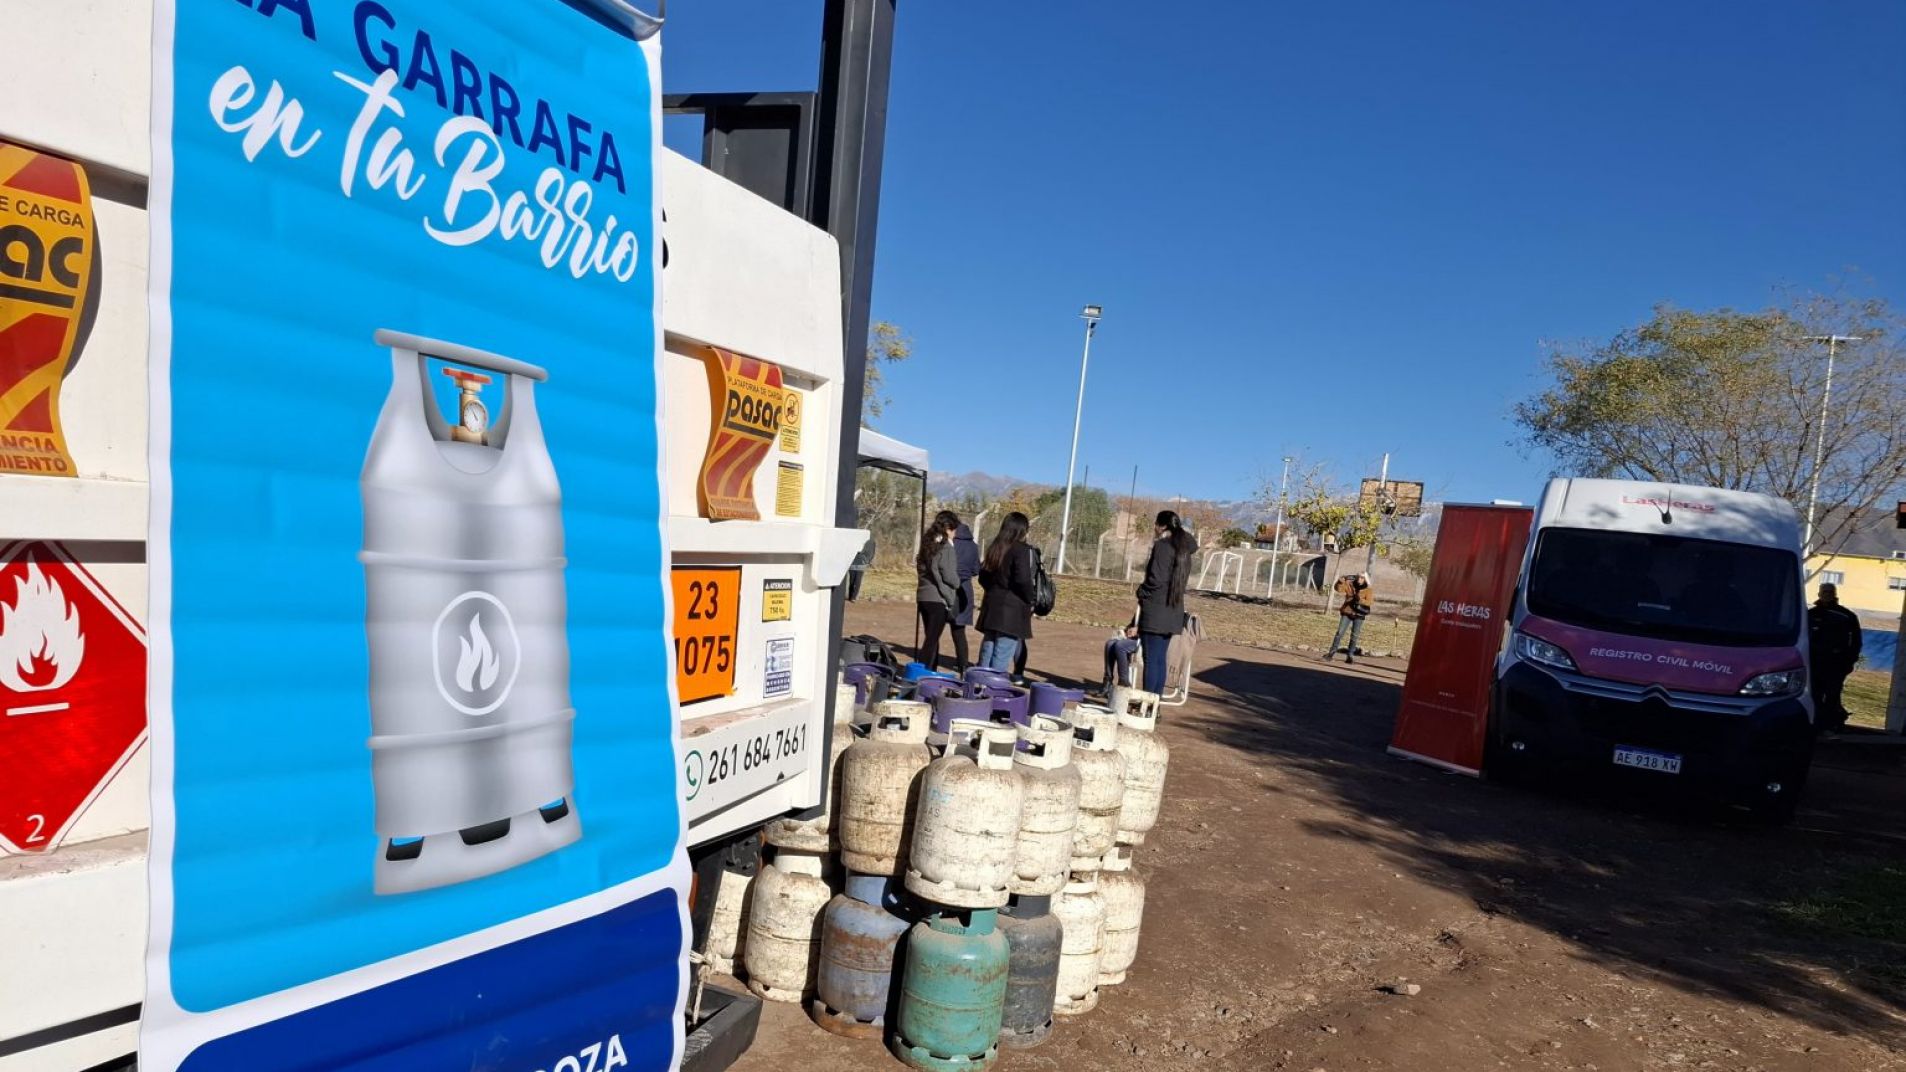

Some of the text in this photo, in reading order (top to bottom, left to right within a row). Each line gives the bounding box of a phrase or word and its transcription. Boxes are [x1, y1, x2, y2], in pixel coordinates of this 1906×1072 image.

[353, 0, 626, 194] GARRAFA
[209, 65, 321, 162] en
[423, 115, 639, 282] Barrio
[15, 199, 84, 229] CARGA
[687, 580, 719, 620] 23
[1437, 600, 1455, 614] LAS
[1589, 647, 1733, 675] REGISTRO CIVIL MÓVIL
[708, 723, 806, 785] 261 684 7661
[1617, 752, 1633, 765] AE
[1636, 754, 1658, 769] 918
